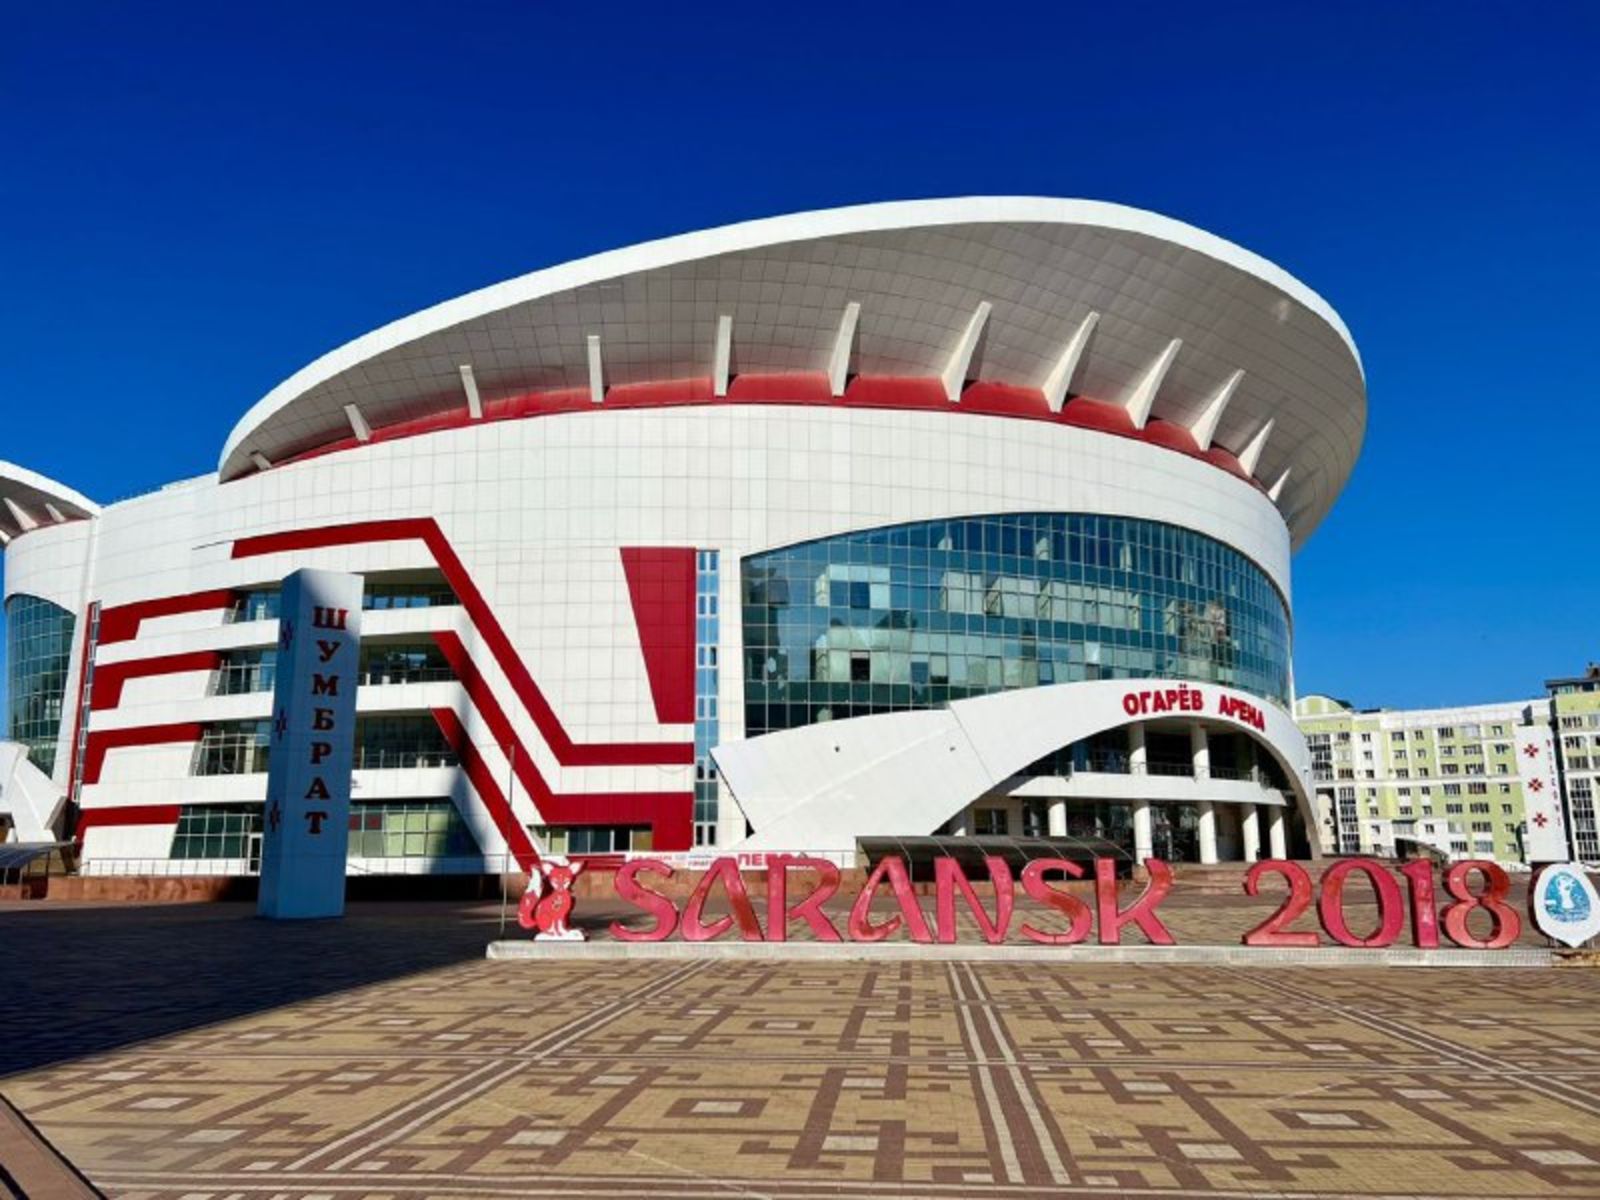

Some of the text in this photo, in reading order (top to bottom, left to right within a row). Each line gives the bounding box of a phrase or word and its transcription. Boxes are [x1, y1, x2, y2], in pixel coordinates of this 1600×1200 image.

[304, 606, 349, 834] ШУМБРАТ
[1122, 683, 1266, 732] ОГАРЁВ АРЕНА
[609, 856, 1522, 949] SARANSK 2018
